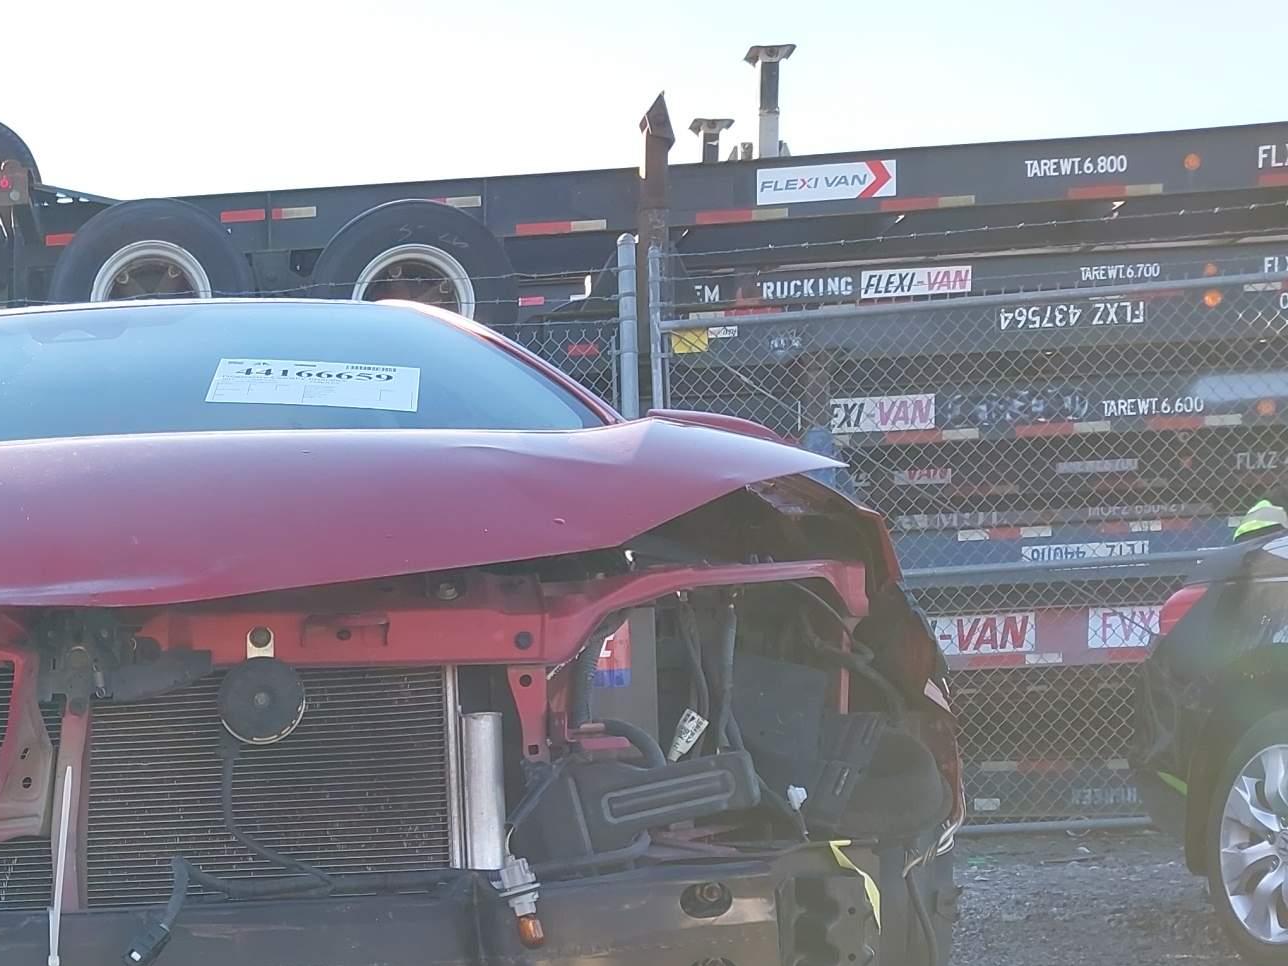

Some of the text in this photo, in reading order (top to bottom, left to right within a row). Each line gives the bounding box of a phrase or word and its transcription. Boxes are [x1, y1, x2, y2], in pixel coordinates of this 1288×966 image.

[760, 173, 868, 193] FLEXI VAN
[757, 276, 853, 300] RUCKING
[999, 301, 1145, 330] FLXZ 437564
[235, 366, 394, 383] 44166659
